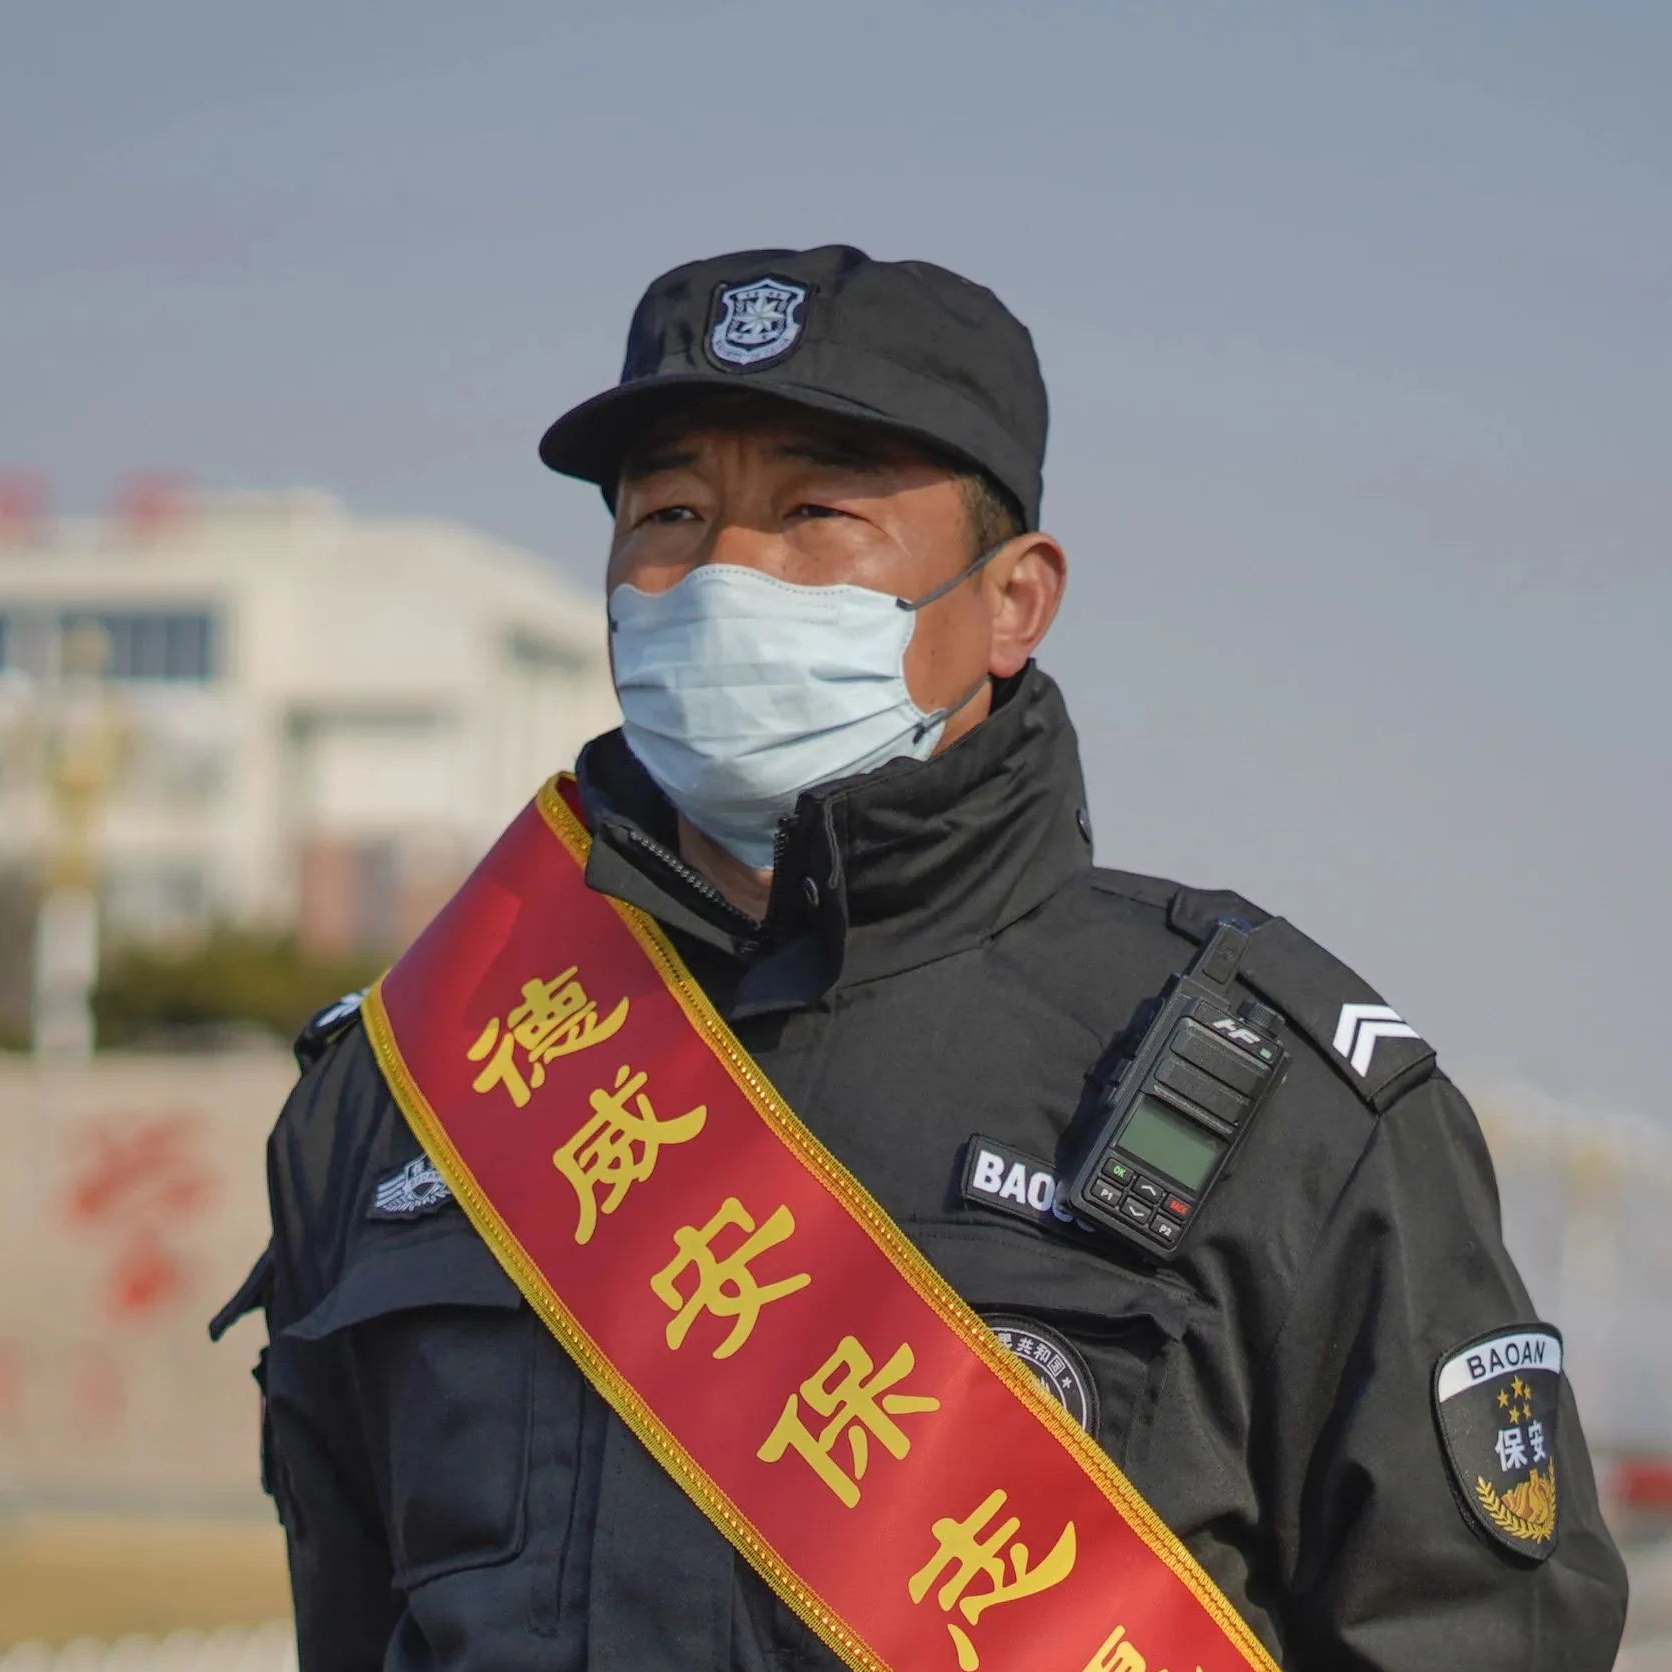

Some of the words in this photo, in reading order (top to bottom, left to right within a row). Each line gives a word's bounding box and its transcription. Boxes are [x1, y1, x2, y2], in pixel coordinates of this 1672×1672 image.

[1113, 1166, 1126, 1178] OK
[972, 1150, 1095, 1233] BAO
[1100, 1188, 1114, 1201] P1
[1159, 1224, 1172, 1237] P2
[1466, 1341, 1546, 1380] BAOAN
[1495, 1421, 1547, 1472] 保安
